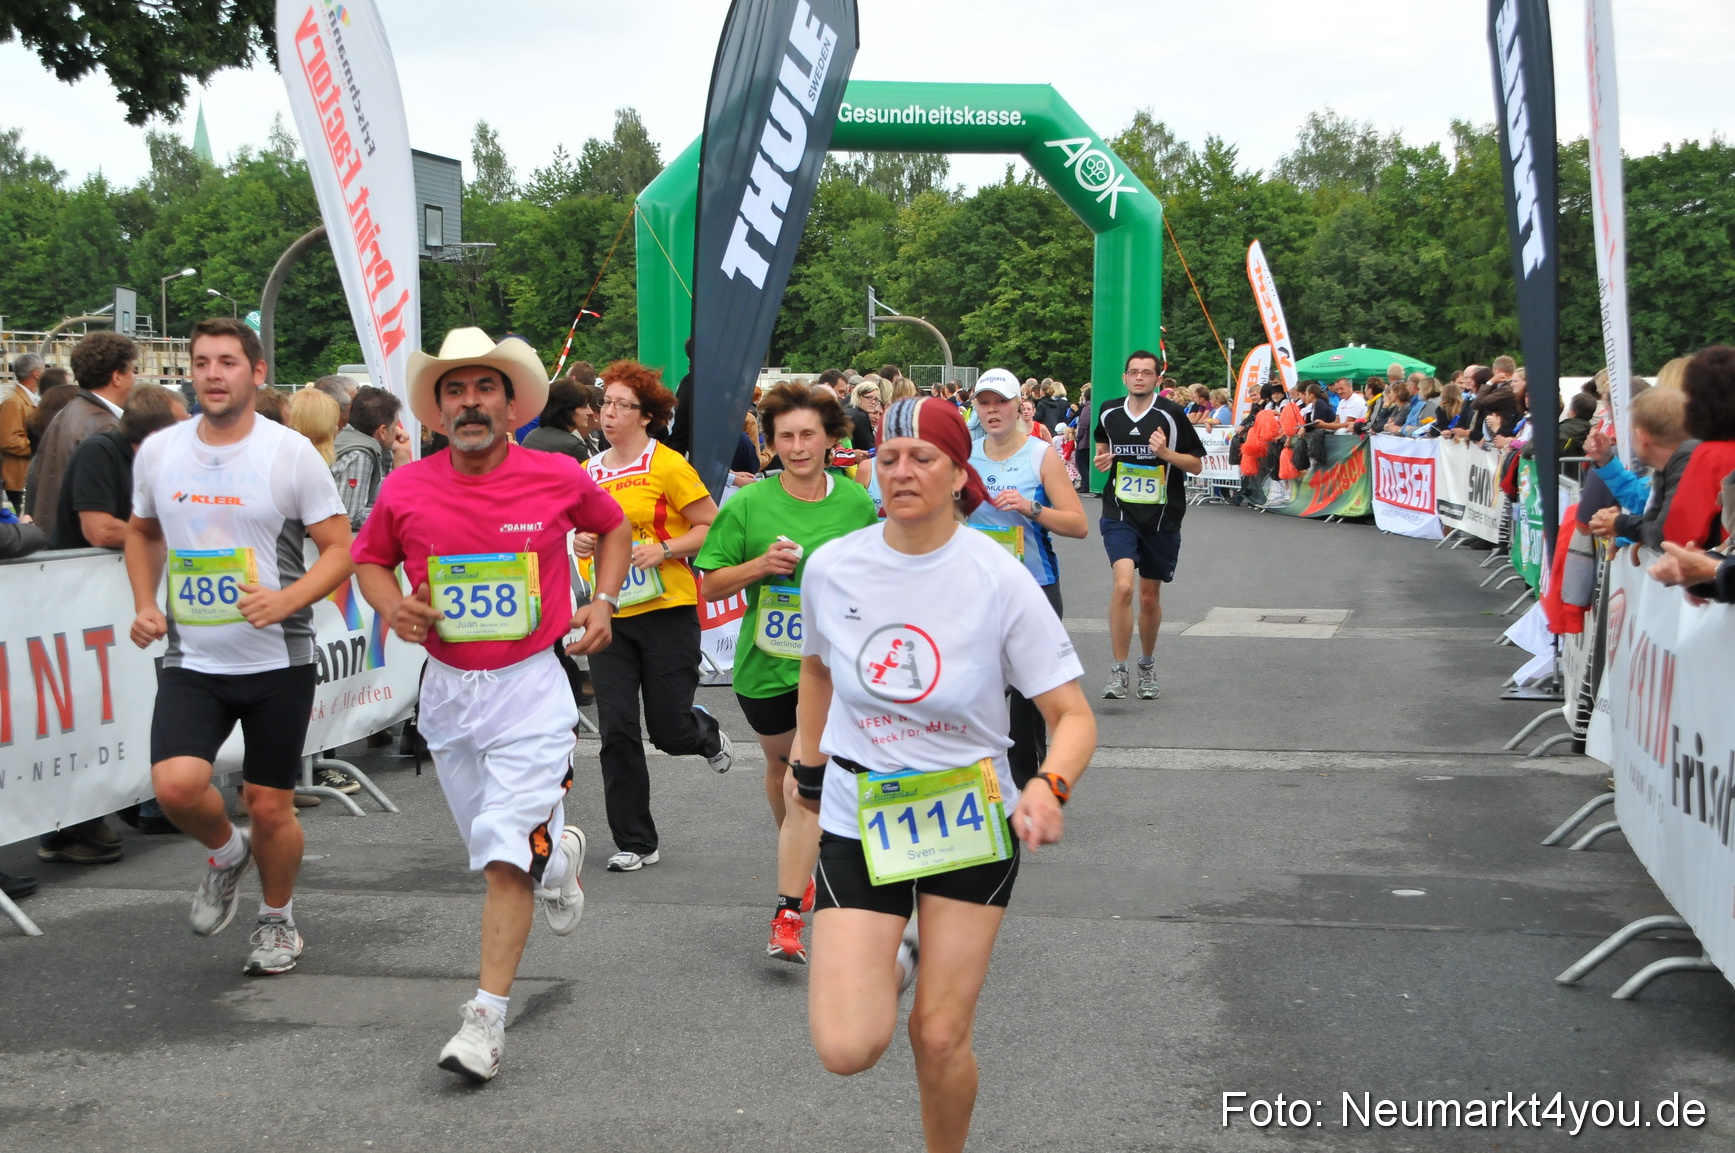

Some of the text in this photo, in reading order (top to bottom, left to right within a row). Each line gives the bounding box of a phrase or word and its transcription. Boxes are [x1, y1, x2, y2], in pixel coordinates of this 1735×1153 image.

[808, 37, 831, 102] SWEDEN
[837, 103, 1027, 126] Gesundheitskasse.
[721, 0, 837, 290] THULE
[1043, 137, 1139, 219] AOK
[616, 477, 651, 492] BÖGL
[1121, 476, 1156, 494] 215
[1377, 456, 1432, 510] MEIER
[191, 494, 245, 506] KLEBL
[179, 575, 239, 606] 486
[443, 583, 517, 620] 358
[456, 620, 478, 629] Juan
[316, 635, 366, 686] ann
[341, 685, 393, 711] Medien
[871, 733, 898, 744] Heck
[868, 792, 985, 850] 1114
[907, 848, 936, 860] Sven
